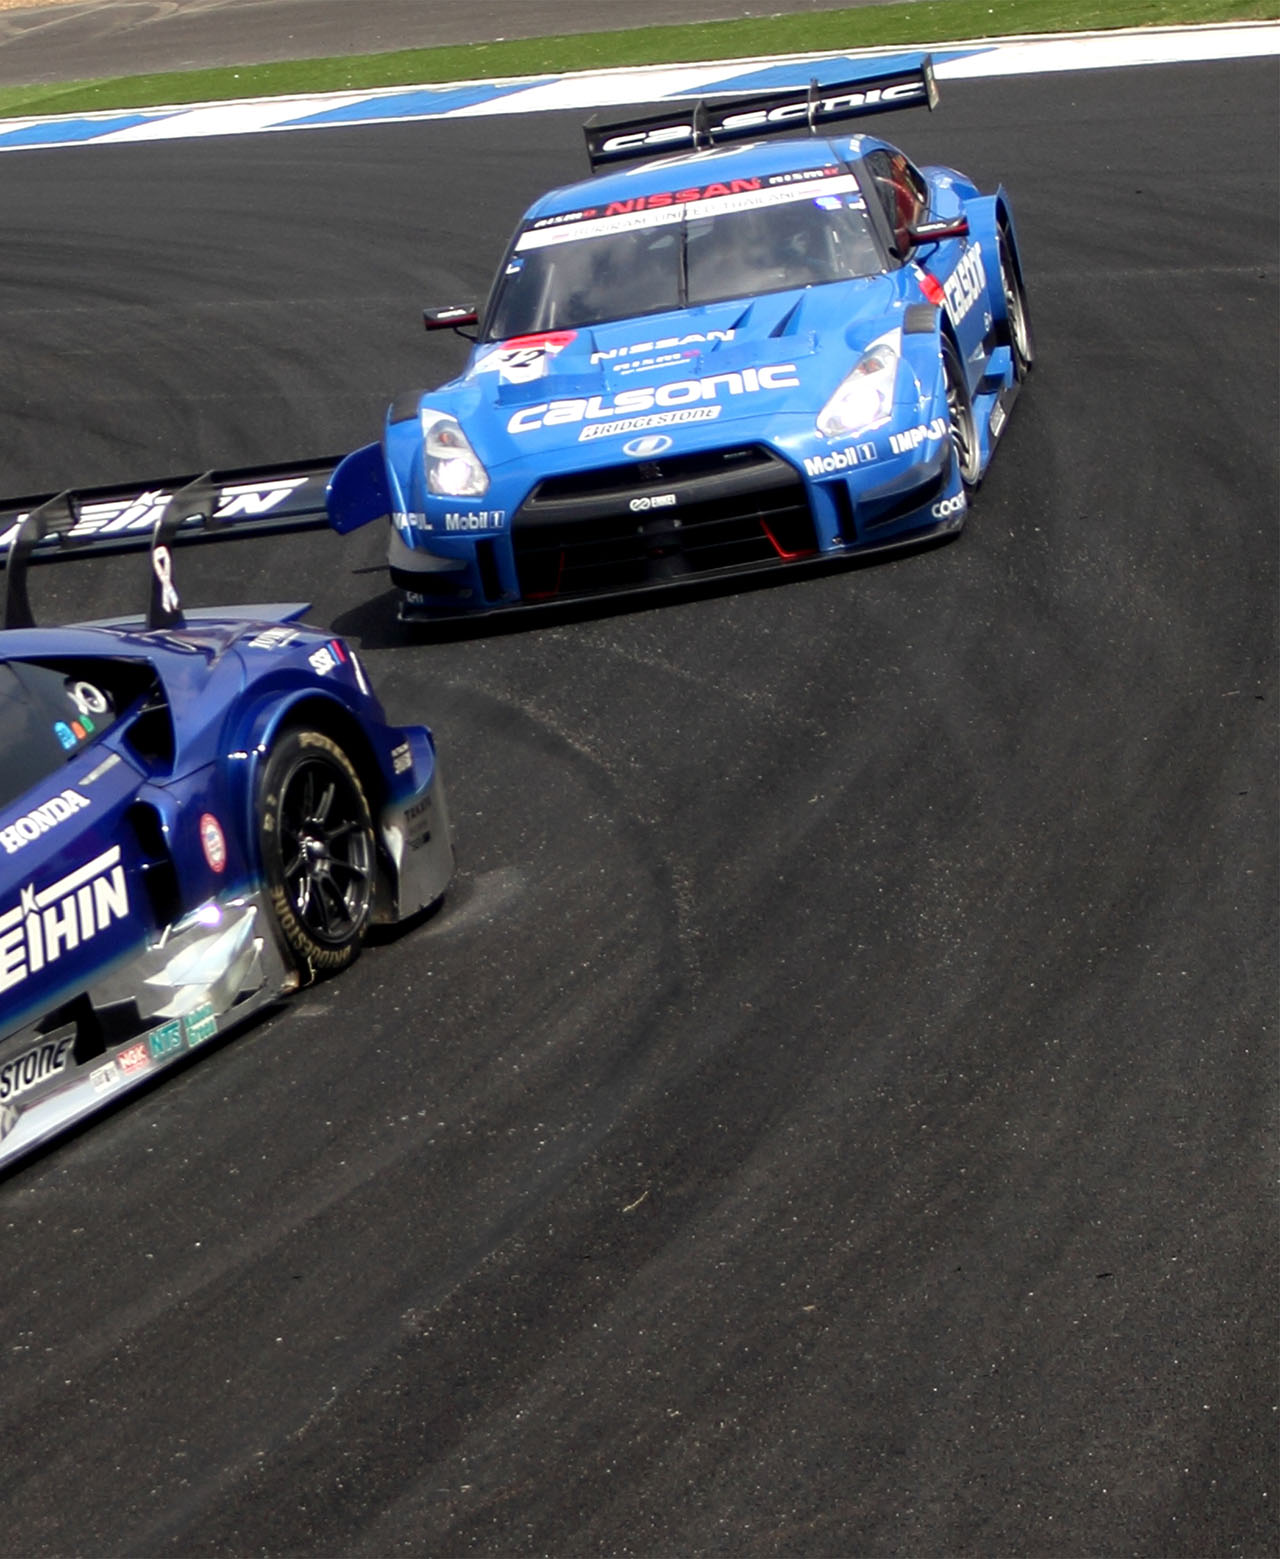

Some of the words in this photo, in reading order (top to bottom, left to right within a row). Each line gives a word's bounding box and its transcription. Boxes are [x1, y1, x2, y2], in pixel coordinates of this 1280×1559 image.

[603, 82, 924, 152] CASONIC
[604, 176, 761, 216] NISSAN
[590, 329, 736, 364] NISSAN
[507, 363, 801, 434] CALSONIC
[584, 408, 714, 438] BRIDGESTONE
[803, 447, 858, 476] Mobil
[445, 512, 488, 531] Mobil
[118, 1044, 147, 1070] NGK
